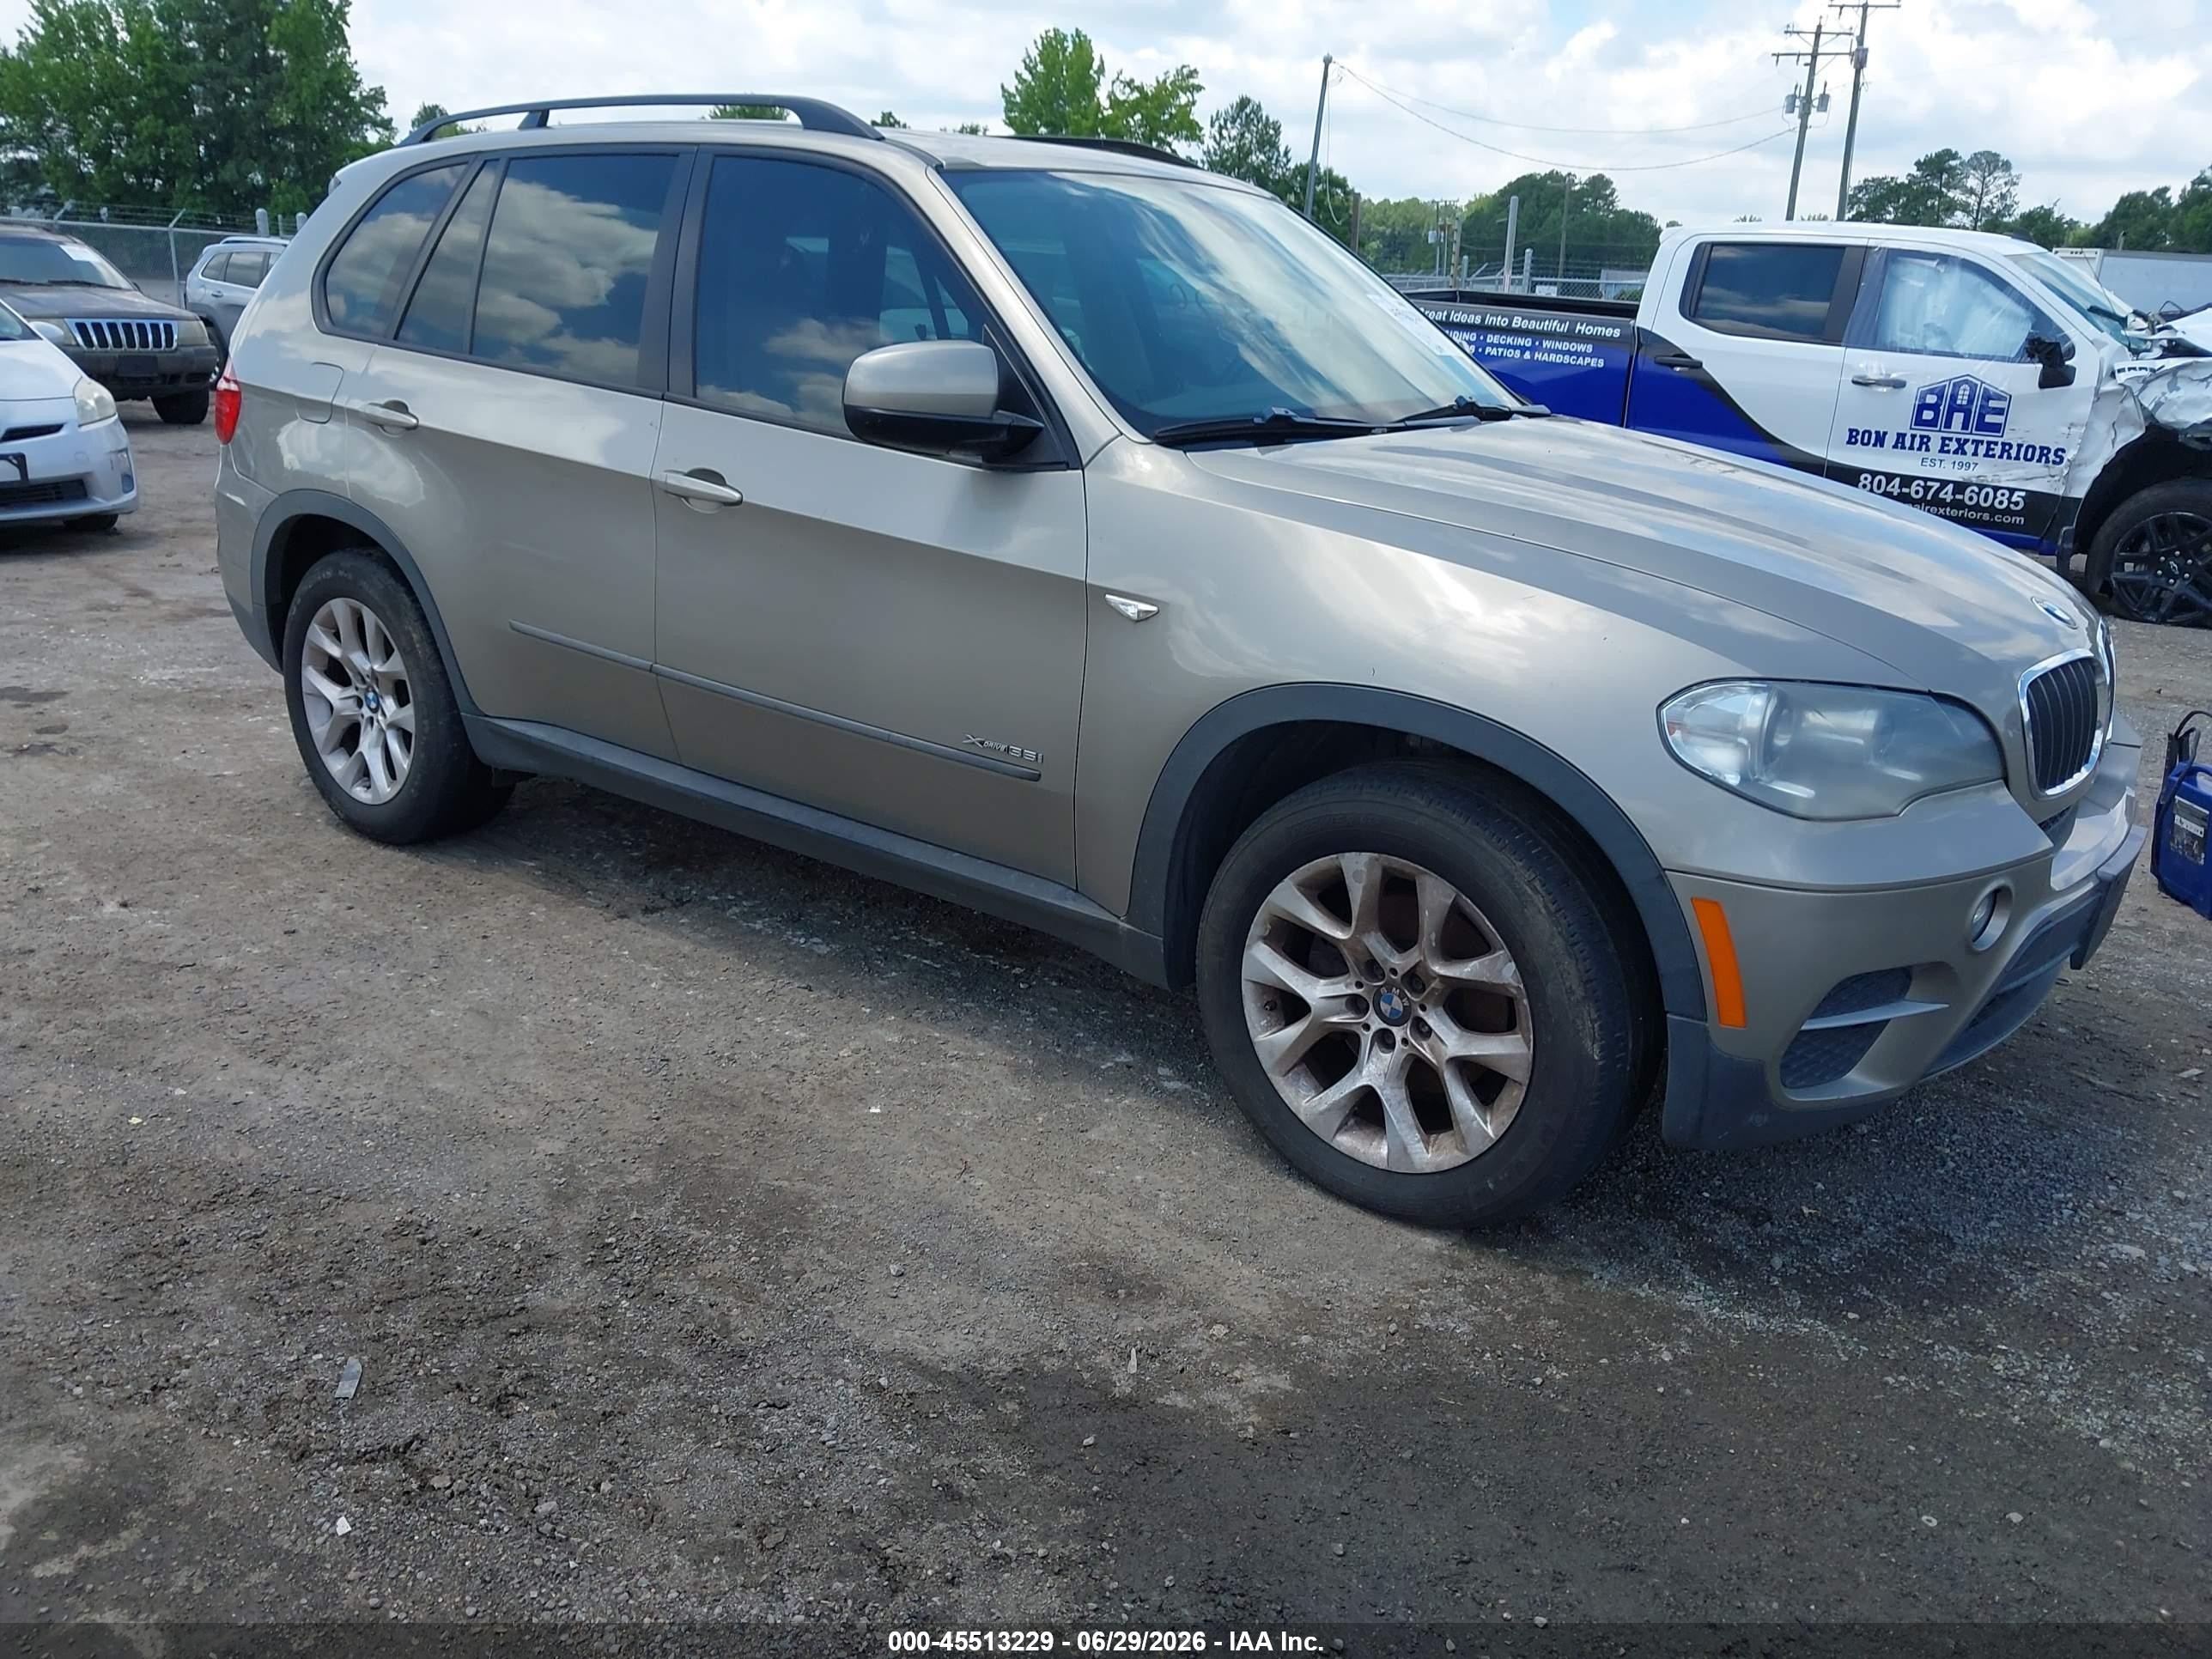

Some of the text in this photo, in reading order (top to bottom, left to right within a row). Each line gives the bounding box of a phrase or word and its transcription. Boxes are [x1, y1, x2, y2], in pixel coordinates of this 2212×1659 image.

[1449, 308, 1481, 325] Ideas
[1485, 313, 1509, 327] Into
[1511, 315, 1569, 333] Beautiful
[1575, 322, 1621, 337] Homes
[1485, 347, 1521, 359] PATIOS
[1523, 349, 1531, 360] &
[1534, 351, 1605, 368] HARDSCAPES
[1486, 334, 1532, 347] DECKING
[1542, 339, 1594, 353] WINDOWS
[1910, 375, 2012, 437] BAE
[1845, 428, 2067, 465] BON AIR EXTERIORS
[1920, 457, 1979, 471] EST. 1997
[1857, 472, 2027, 511] 804-674-6085
